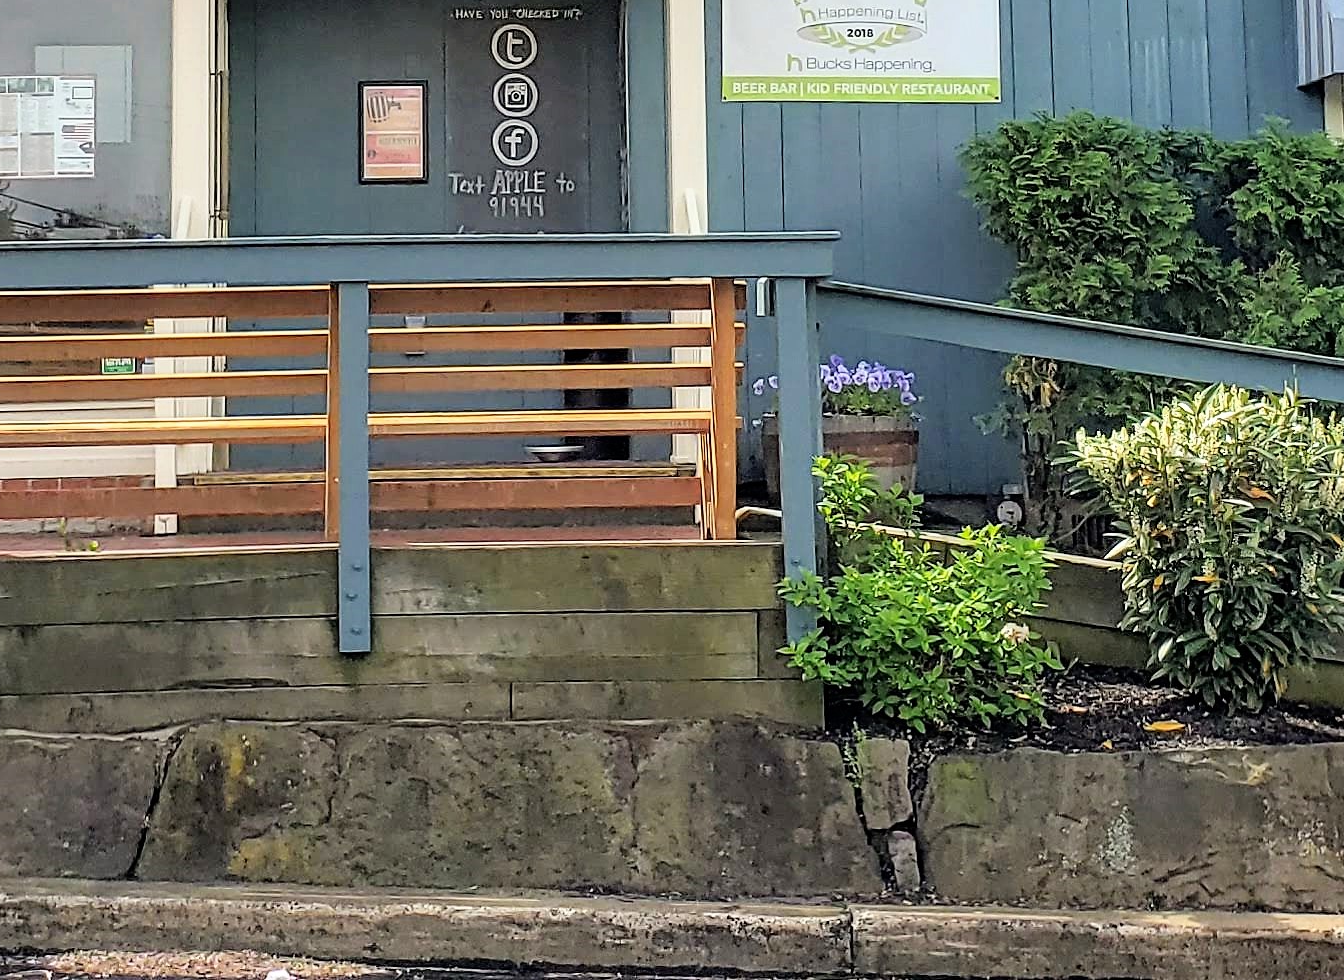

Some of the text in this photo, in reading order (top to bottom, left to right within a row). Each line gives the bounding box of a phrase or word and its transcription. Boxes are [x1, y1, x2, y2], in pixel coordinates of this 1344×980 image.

[456, 9, 482, 18] HAVE
[490, 9, 508, 19] YOU
[818, 6, 893, 19] Happening
[847, 28, 874, 38] 2018
[807, 58, 851, 70] Bucks
[733, 83, 766, 93] BEER
[770, 84, 797, 93] BAR
[807, 83, 831, 94] KID
[834, 84, 898, 94] FRIENDLY
[901, 84, 990, 95] RESTAURANT
[448, 170, 574, 195] Text APPLE to
[489, 196, 544, 218] 91944
